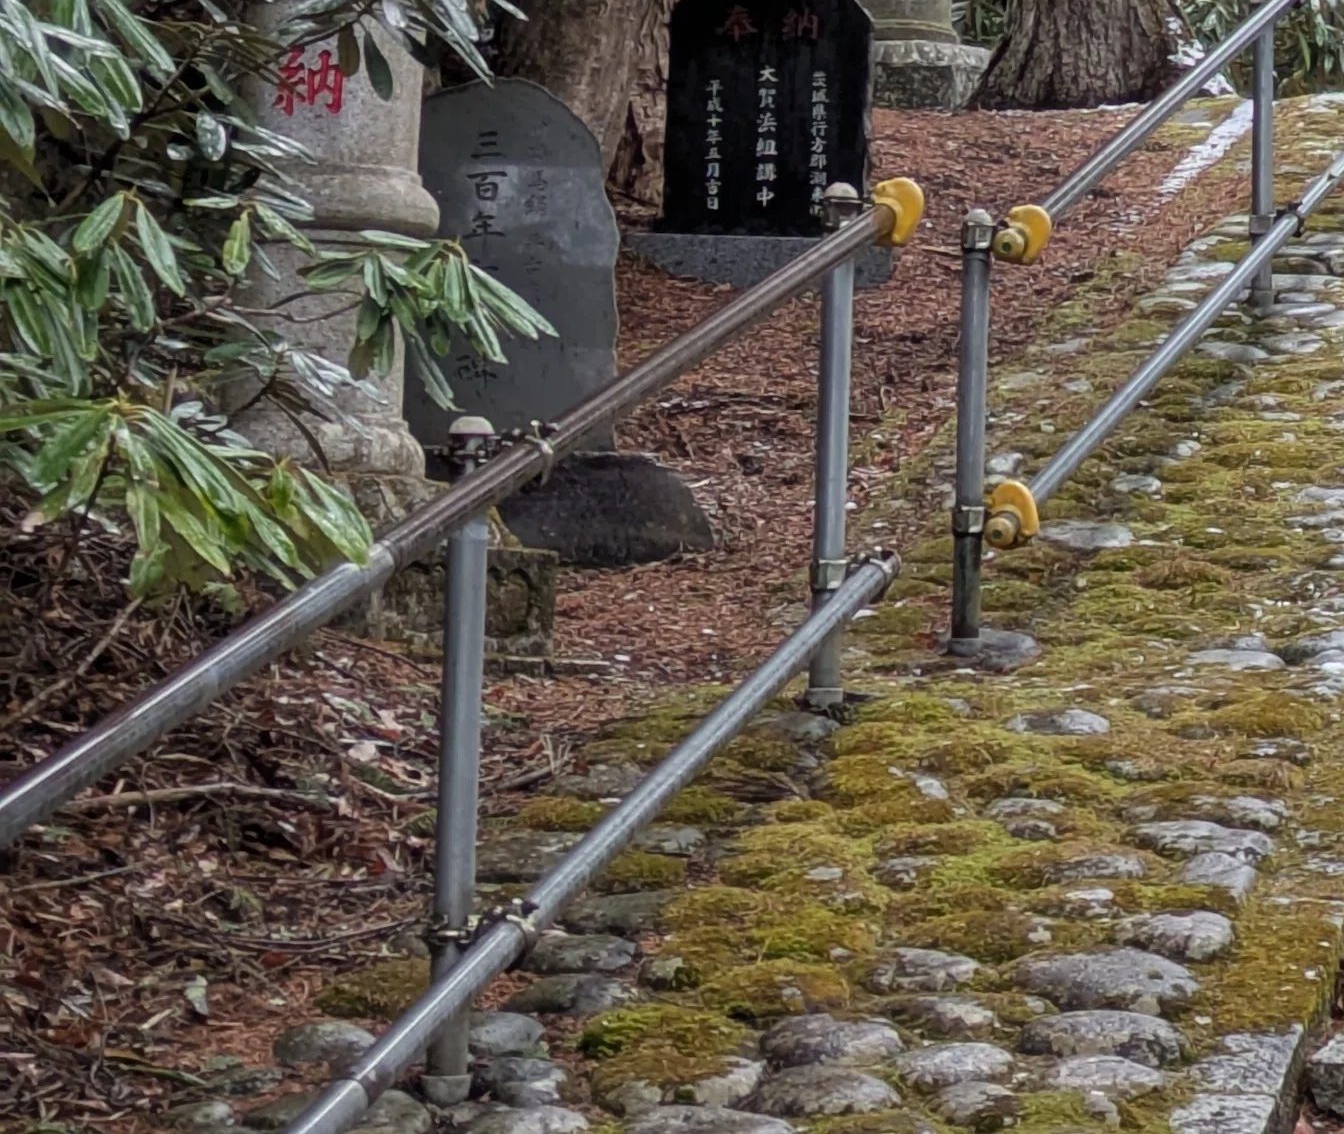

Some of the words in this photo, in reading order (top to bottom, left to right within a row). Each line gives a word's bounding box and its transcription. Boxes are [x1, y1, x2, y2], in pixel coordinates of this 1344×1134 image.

[271, 44, 345, 116] 納
[705, 79, 724, 210] 平成十年五月吉日
